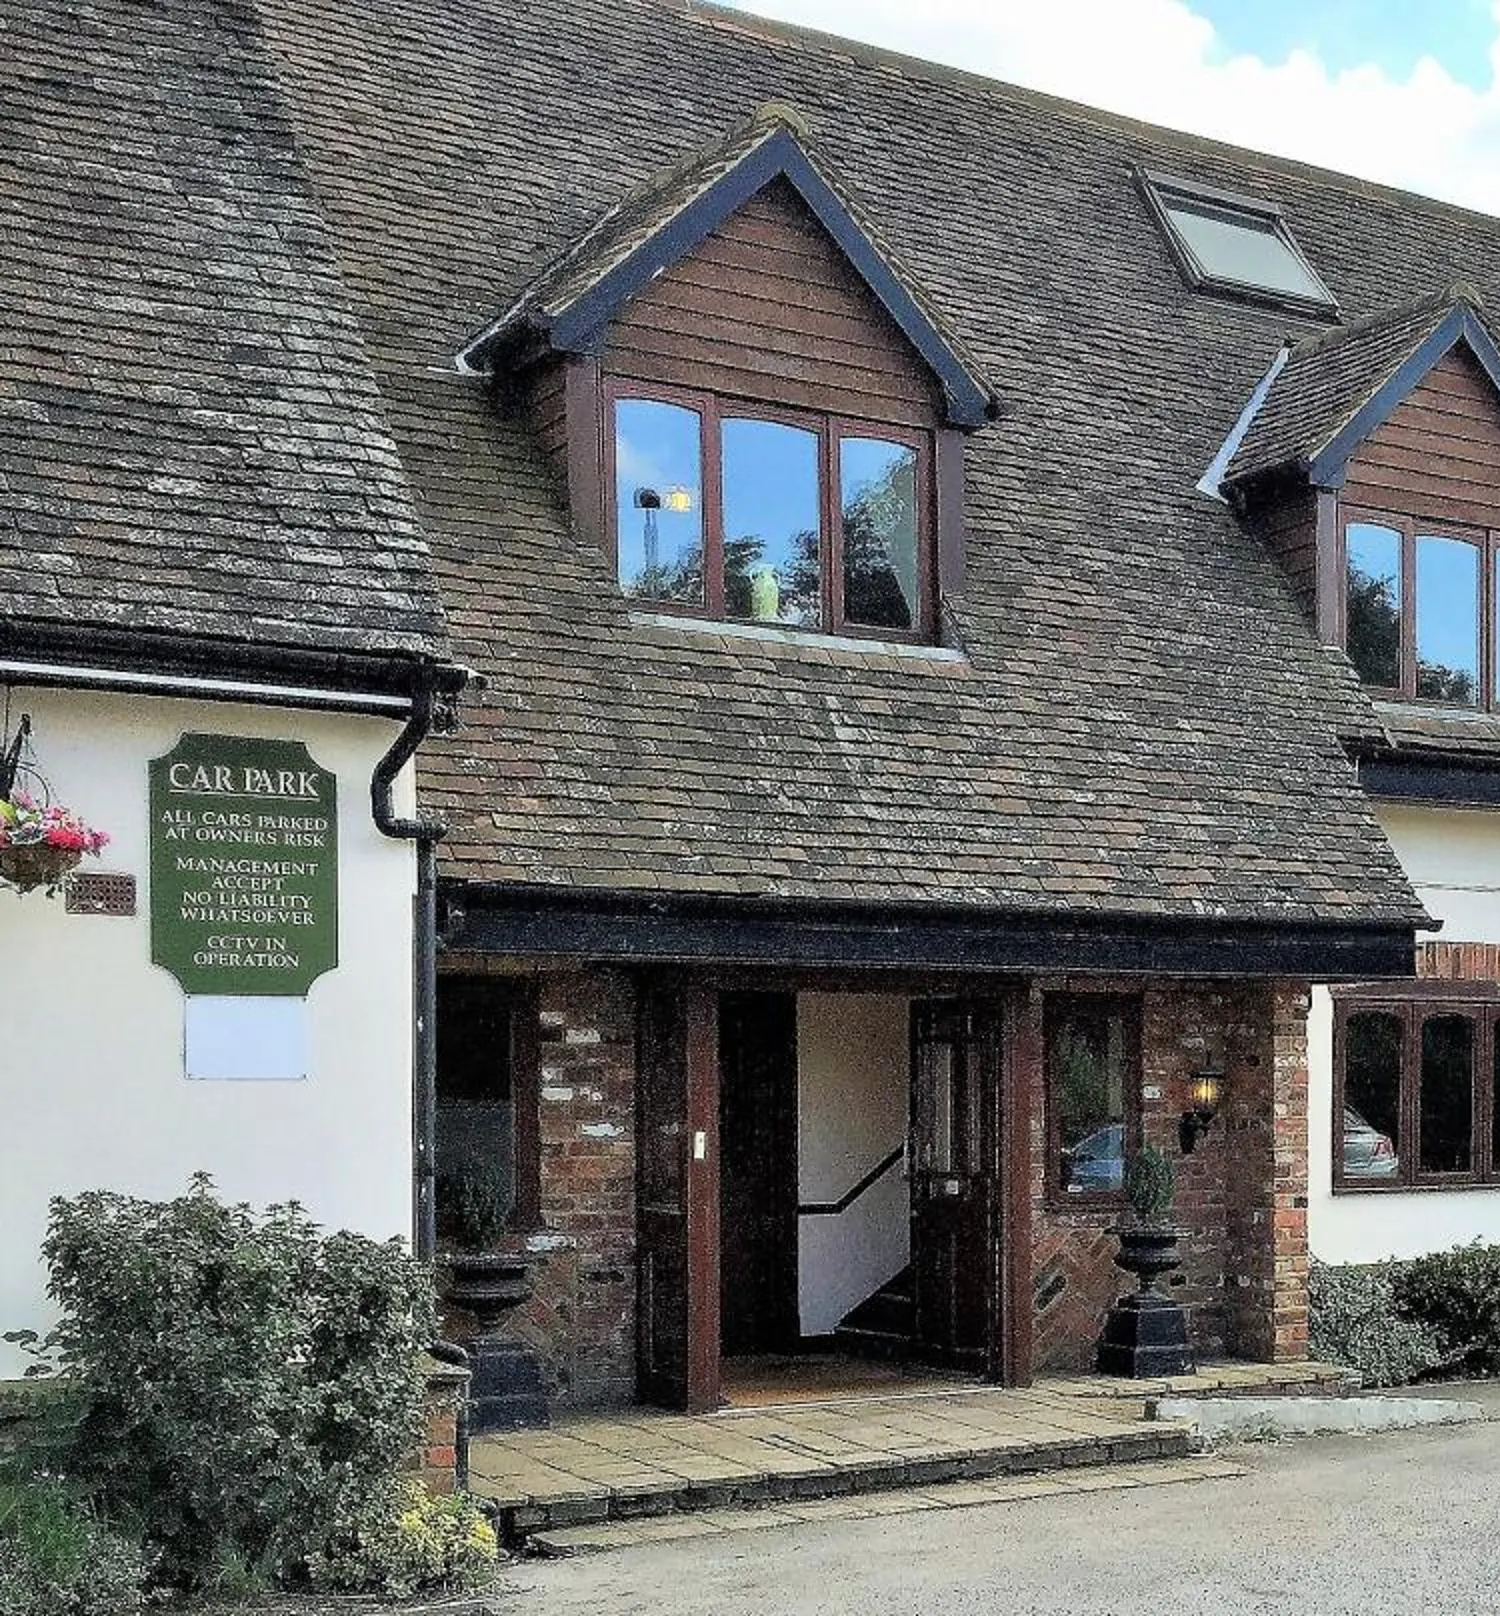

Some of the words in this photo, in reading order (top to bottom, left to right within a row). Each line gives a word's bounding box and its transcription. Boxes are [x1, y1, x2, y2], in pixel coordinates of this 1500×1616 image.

[169, 763, 234, 792] CAR
[243, 767, 319, 797] PARK
[161, 810, 194, 824] ALL
[202, 811, 252, 828] CARS
[258, 815, 328, 832] PARKED
[165, 828, 190, 841] AT
[196, 828, 277, 845] OWNERS
[284, 832, 325, 848] RISK
[176, 857, 318, 876] MANAGEMENT
[212, 877, 285, 891] ACCEPT
[184, 891, 212, 905] NO
[219, 892, 312, 910] LIABILITY
[180, 907, 315, 926] WHATSOEVER
[207, 935, 259, 950] CCTV
[266, 937, 287, 951] IN
[194, 952, 299, 967] OPERATION
